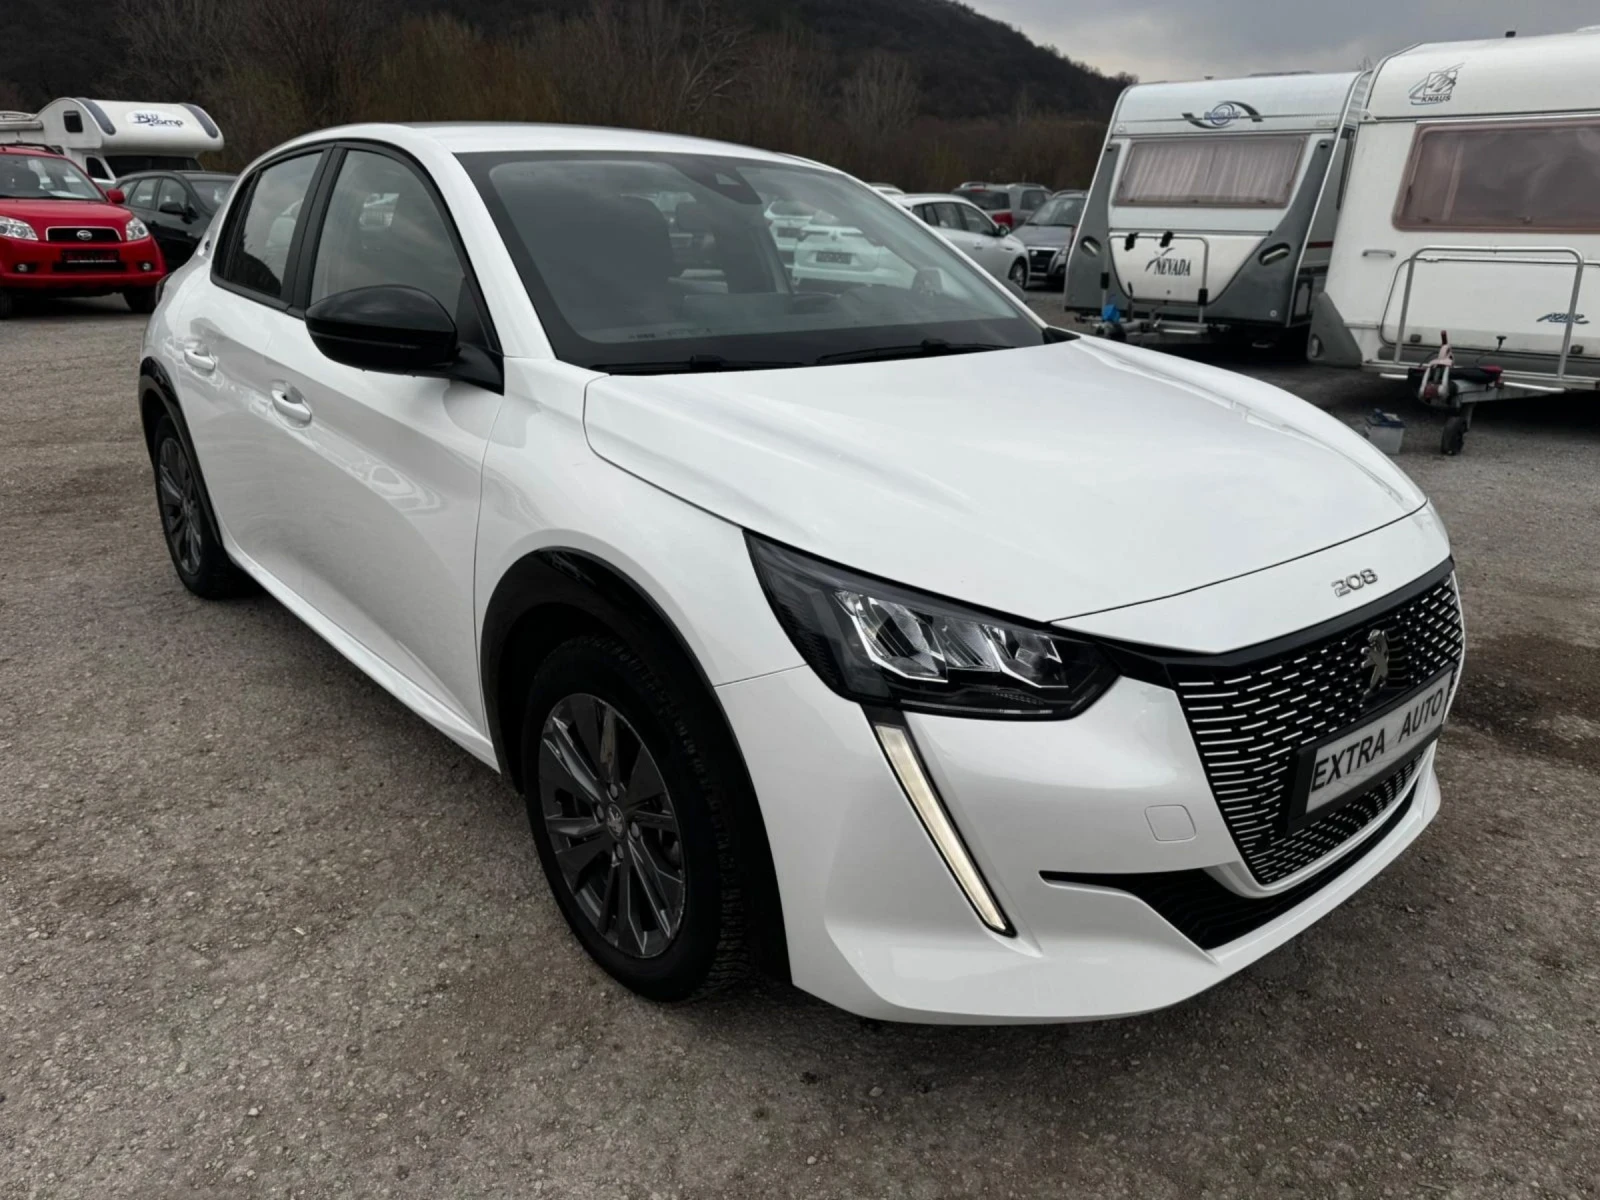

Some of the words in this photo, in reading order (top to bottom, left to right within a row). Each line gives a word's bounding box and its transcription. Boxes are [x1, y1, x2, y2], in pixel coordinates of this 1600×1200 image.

[1421, 95, 1451, 103] KNAUS
[1153, 257, 1191, 276] NEVADA
[1331, 568, 1378, 598] 208
[1311, 728, 1385, 793] EXTRA
[1398, 687, 1444, 743] AUTO
